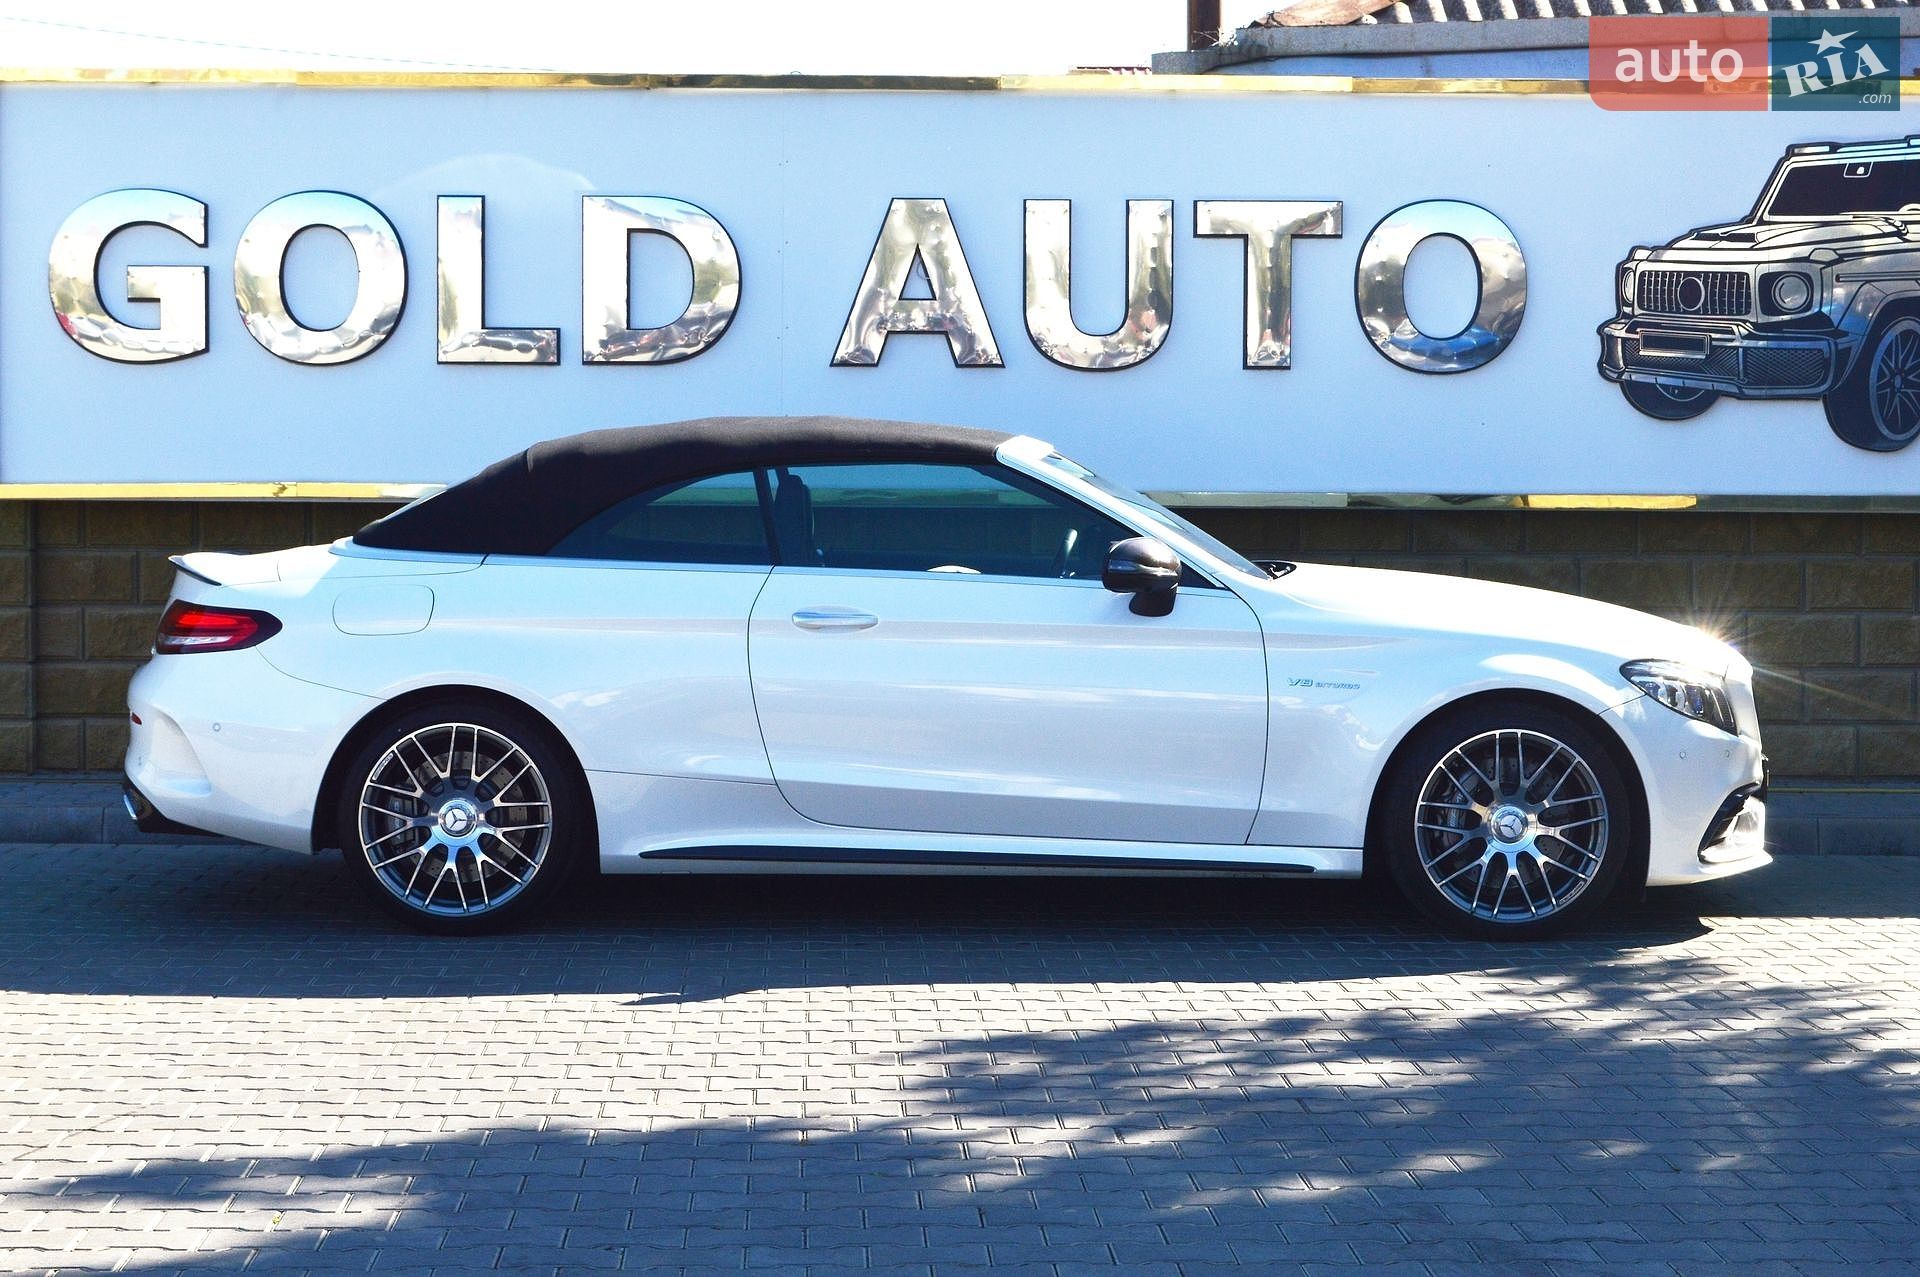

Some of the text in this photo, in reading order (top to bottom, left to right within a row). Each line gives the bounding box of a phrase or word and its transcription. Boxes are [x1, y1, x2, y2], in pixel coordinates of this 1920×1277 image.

[48, 188, 1528, 374] GOLD AUTO
[1287, 677, 1314, 688] V8
